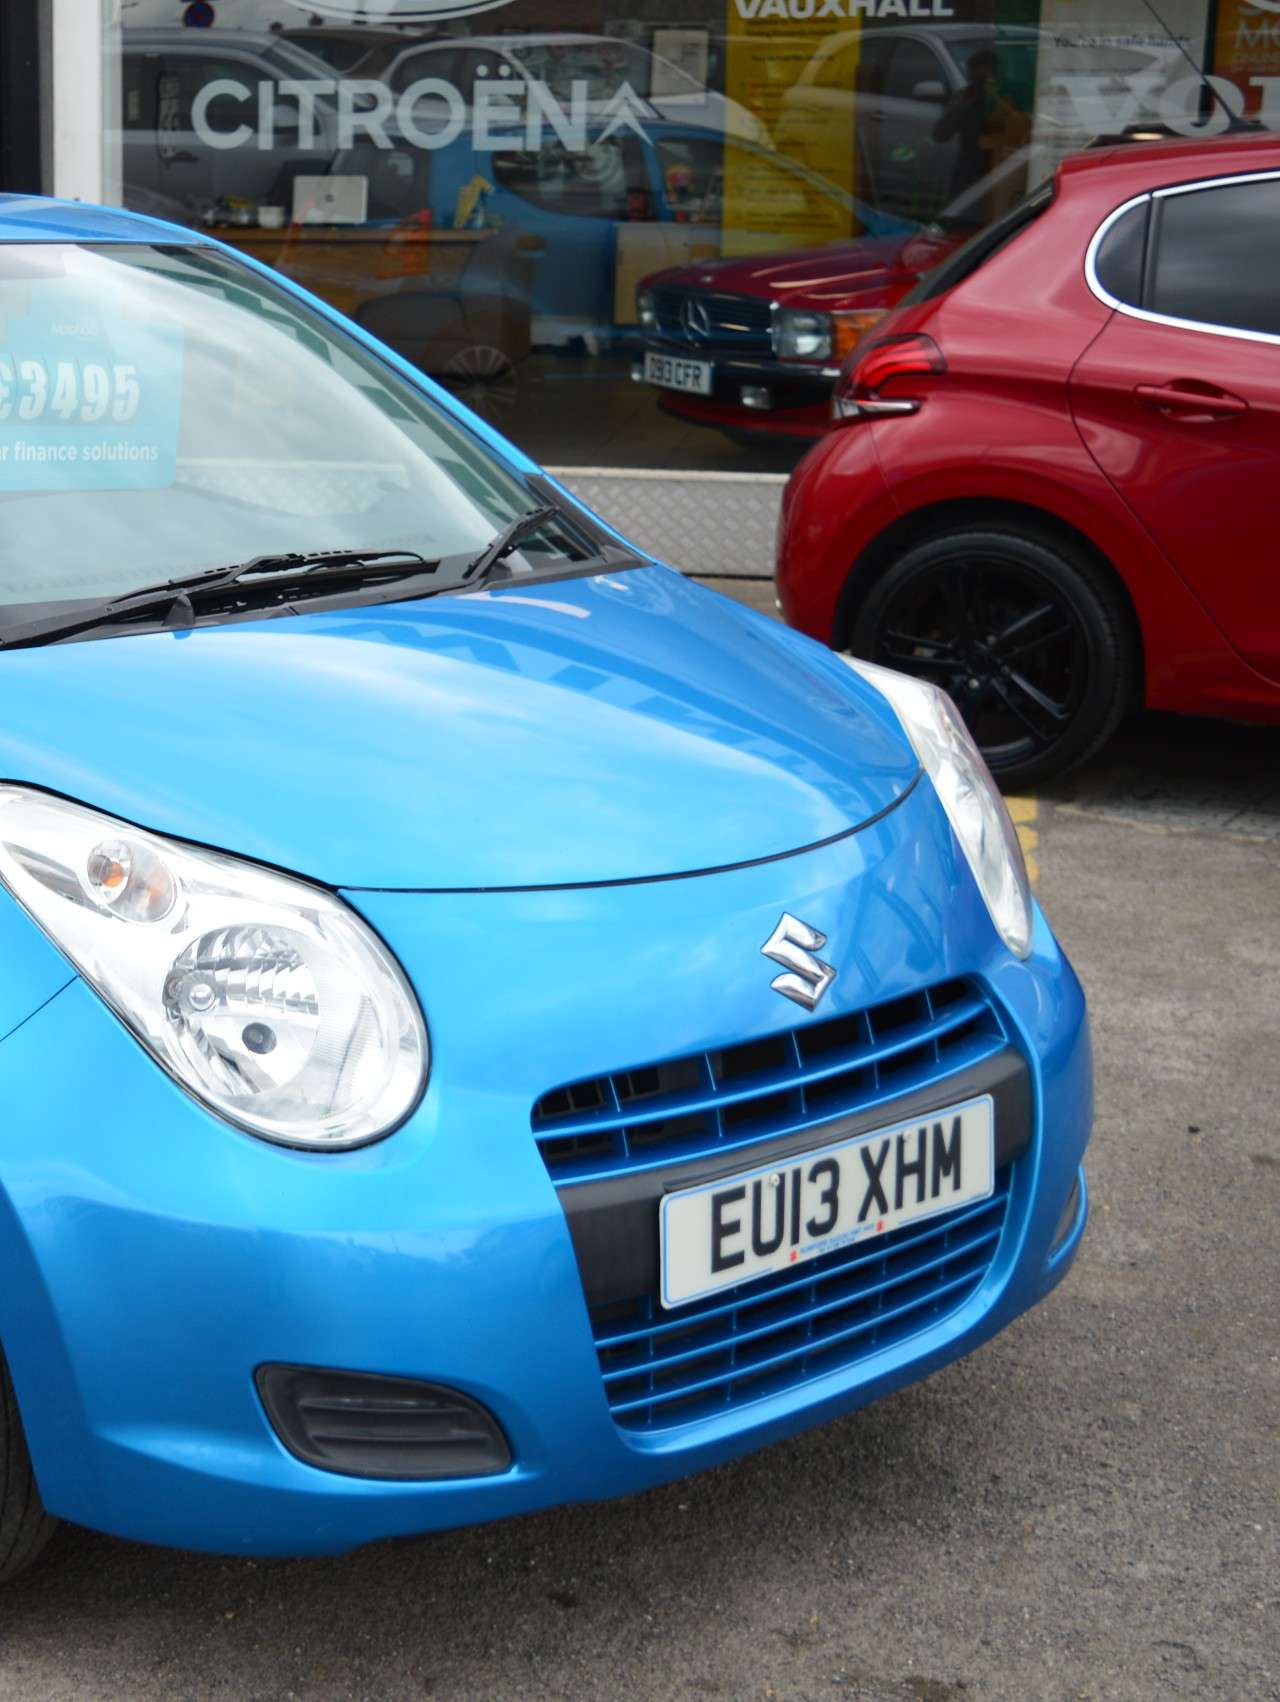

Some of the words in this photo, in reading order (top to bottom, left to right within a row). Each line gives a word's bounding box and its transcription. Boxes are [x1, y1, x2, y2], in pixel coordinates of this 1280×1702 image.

[735, 0, 954, 18] VAUXHALL
[191, 64, 588, 152] CITROËN
[15, 441, 77, 461] finance
[82, 441, 159, 461] solutions
[710, 1156, 841, 1275] EU13
[857, 1115, 963, 1224] XHM
